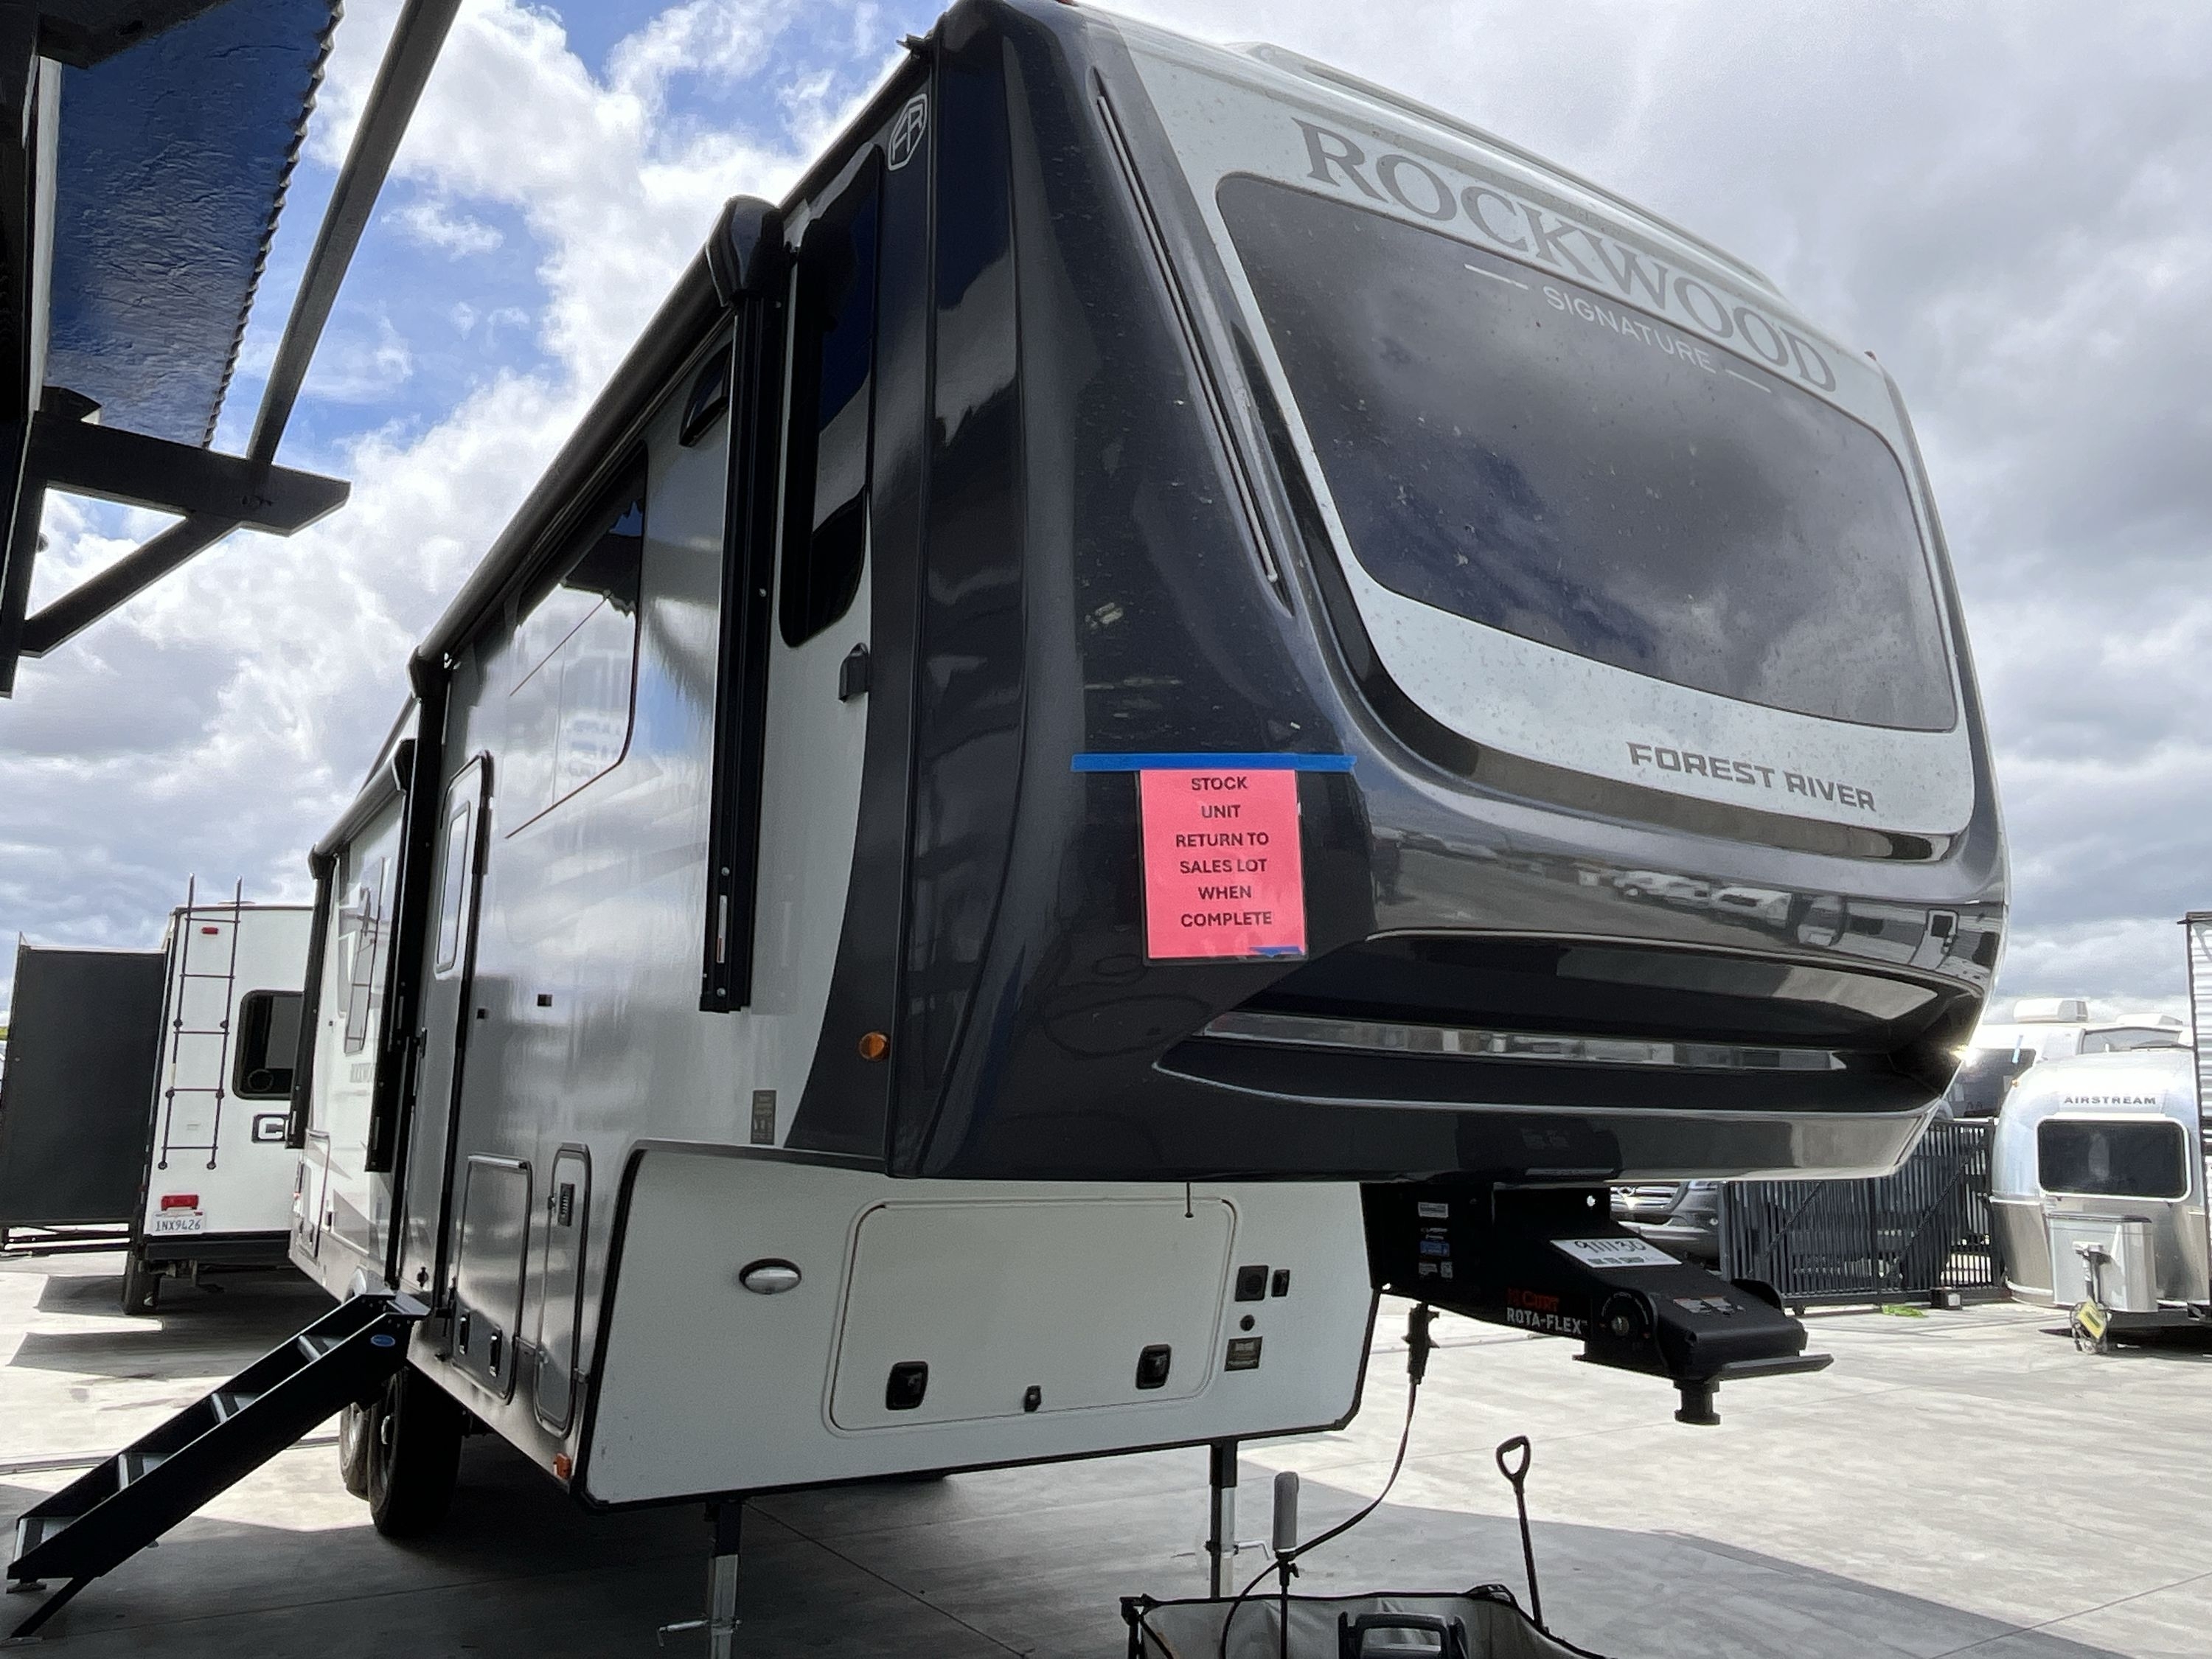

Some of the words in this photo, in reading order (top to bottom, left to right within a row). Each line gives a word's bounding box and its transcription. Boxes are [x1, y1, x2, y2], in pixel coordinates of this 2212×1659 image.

[1293, 118, 1836, 392] ROCKWOOD
[1541, 285, 1716, 372] SIGNATURE
[1192, 776, 1248, 790] STOCK
[1627, 742, 1774, 787] FOREST
[1783, 771, 1877, 811] RIVER
[1201, 805, 1240, 818] UNIT
[1175, 833, 1242, 847] RETURN
[1248, 832, 1269, 845] TO
[1180, 860, 1232, 874] SALES
[1237, 859, 1267, 872] LOT
[1198, 886, 1251, 900] WHEN
[1180, 911, 1272, 927] COMPLETE
[2064, 1096, 2157, 1105] AIRSTREAM
